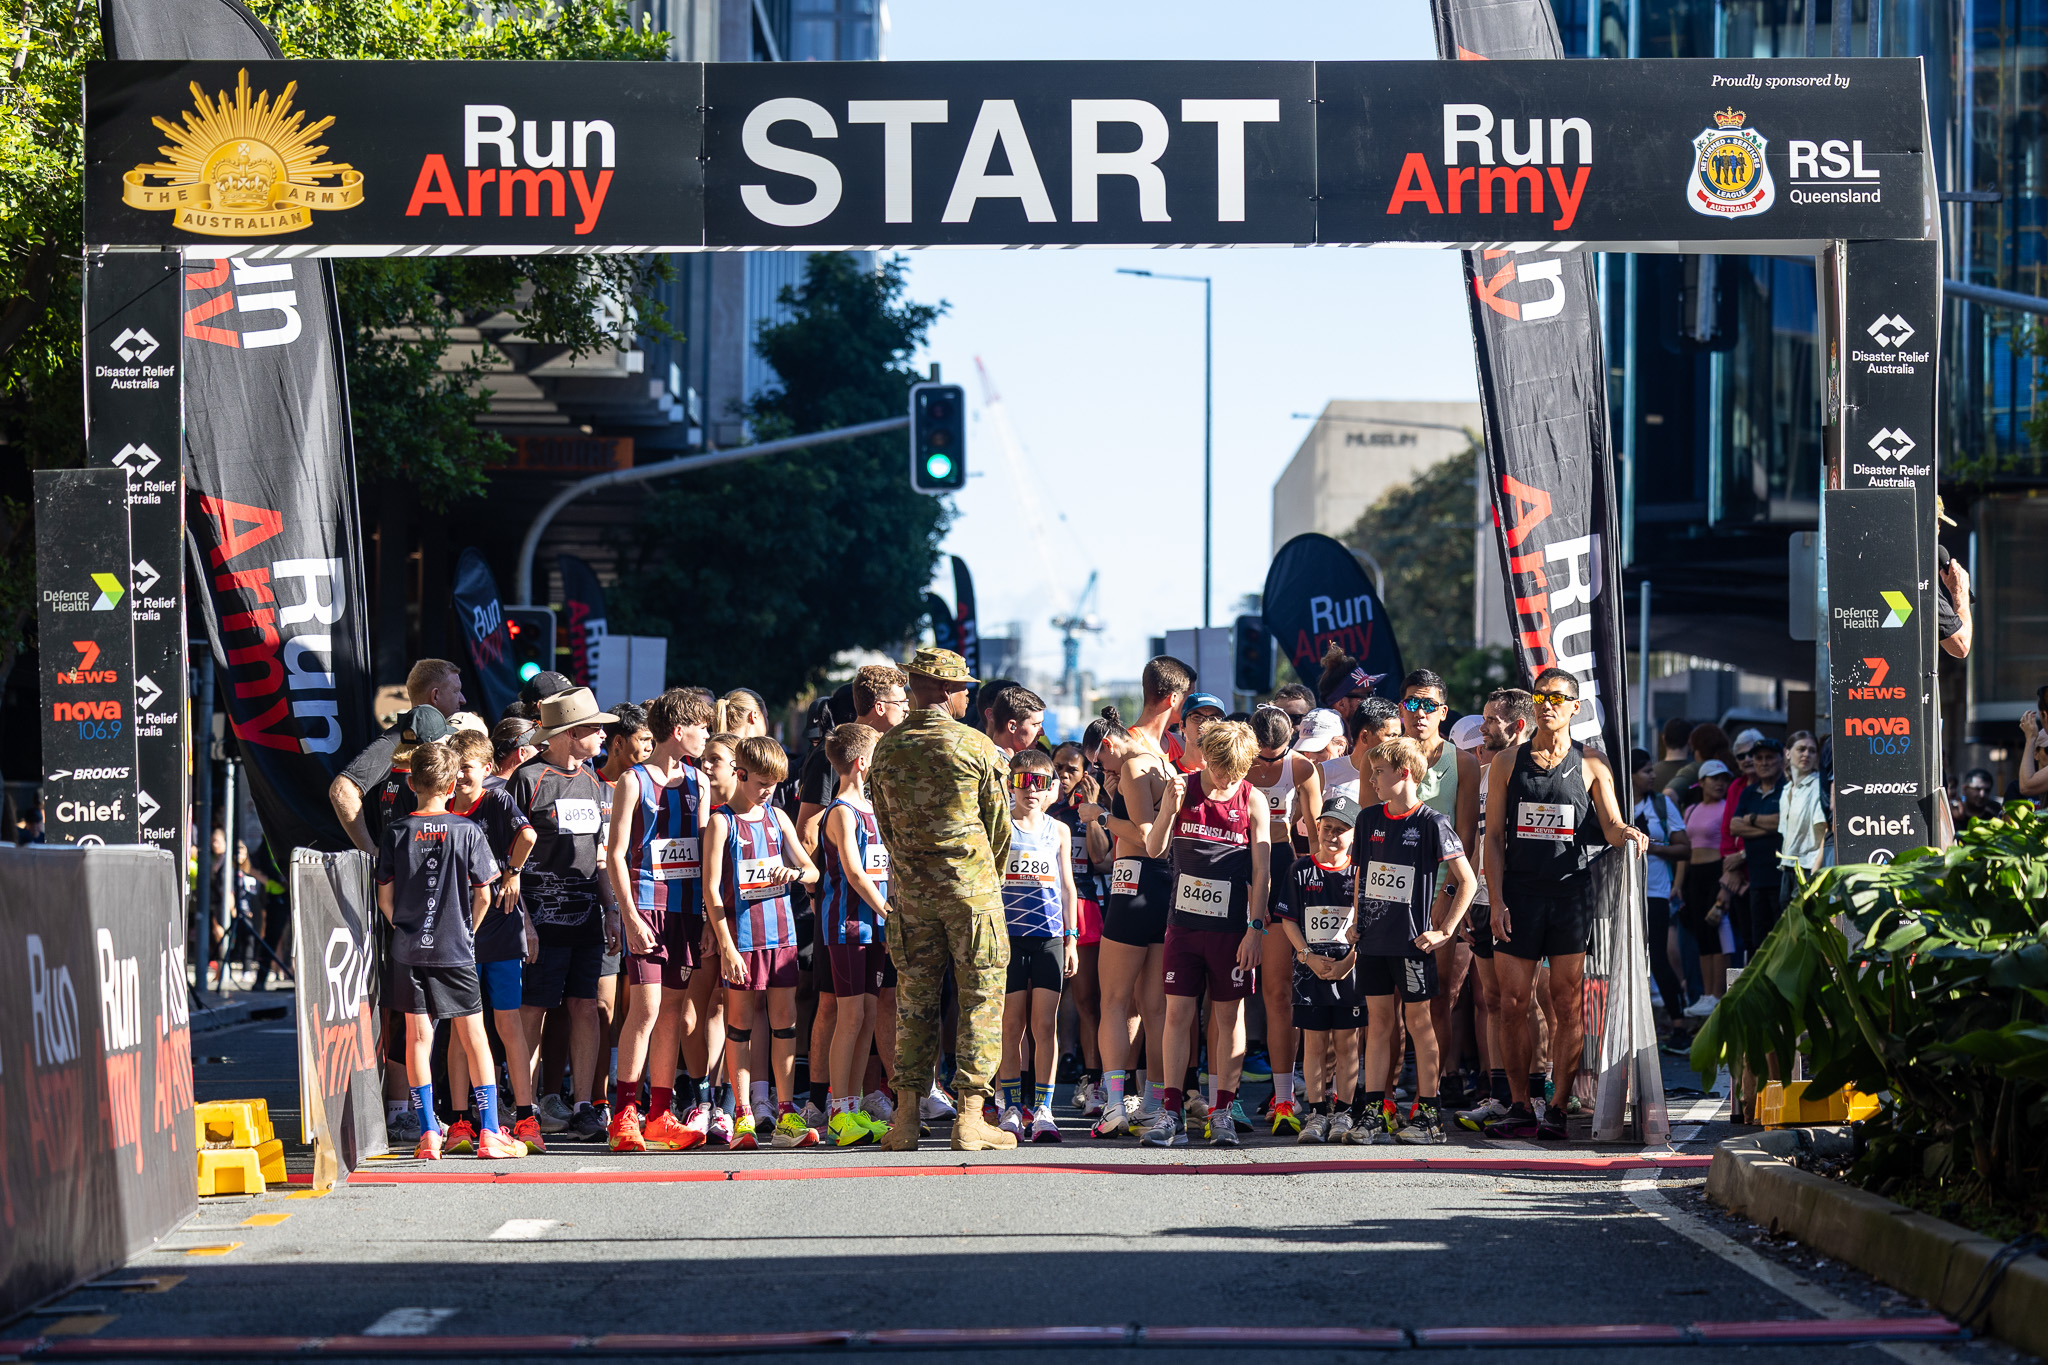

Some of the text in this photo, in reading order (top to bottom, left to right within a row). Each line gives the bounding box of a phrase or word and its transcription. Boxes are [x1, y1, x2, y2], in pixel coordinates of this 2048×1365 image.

[1711, 74, 1850, 89] Proudly sponsored by
[464, 104, 616, 168] Run
[1443, 103, 1592, 165] Run
[740, 97, 1280, 226] START
[1700, 138, 1726, 172] RETURNED
[1732, 138, 1761, 169] SERVICES
[1789, 139, 1880, 179] RSL
[144, 189, 188, 203] THE
[288, 187, 351, 203] ARMY
[405, 153, 614, 234] Army
[1386, 152, 1591, 231] Army
[1716, 189, 1747, 199] LEAGUE
[1789, 189, 1881, 205] Queensland
[1709, 202, 1754, 213] AUSTRALIA
[183, 212, 303, 229] AUSTRALIAN
[1852, 350, 1930, 363] Disaster Relief
[95, 365, 175, 377] Disaster Relief
[1867, 363, 1915, 375] Australia
[110, 378, 160, 389] Australia
[1853, 463, 1931, 476] Disaster Relief
[144, 480, 176, 492] Relief
[1868, 476, 1916, 488] Australia
[129, 493, 161, 505] stralia
[1502, 474, 1557, 680] Arm
[43, 590, 90, 602] Defence
[144, 597, 176, 609] Relief
[52, 601, 90, 612] Health
[1309, 591, 1373, 635] Run
[1834, 607, 1879, 618] Defence
[133, 610, 161, 621] tralia
[200, 494, 301, 754] Army
[1843, 618, 1880, 629] Health
[72, 640, 101, 670] 7
[272, 557, 346, 755] Run
[57, 670, 118, 684] NEWS
[1862, 657, 1890, 686] 7
[1848, 687, 1906, 700] NEWS
[53, 700, 122, 721] nova
[145, 713, 178, 724] Relief
[76, 720, 122, 740] 106.9
[136, 726, 163, 737] tralia
[1844, 716, 1910, 736] nova
[1867, 736, 1911, 755] 106.9
[73, 767, 130, 780] BROOKS
[1864, 782, 1918, 794] BROOKS
[56, 799, 126, 823] Chief.
[564, 808, 596, 821] 8058
[1525, 812, 1566, 828] 5771
[1848, 814, 1915, 836] Chief.
[143, 828, 175, 839] Relief
[423, 822, 448, 833] Run
[1181, 822, 1244, 844] QUEENSLAND
[1374, 829, 1386, 837] Run
[414, 830, 448, 843] Army
[1369, 834, 1386, 843] Army
[1402, 839, 1418, 848] Army
[658, 848, 694, 863] 7441
[873, 854, 890, 868] 53
[1010, 860, 1050, 874] 6280
[1370, 871, 1406, 889] 8626
[1183, 885, 1222, 903] 8406
[1311, 917, 1349, 930] 8627
[97, 927, 142, 1052] Run
[26, 934, 82, 1067] Run
